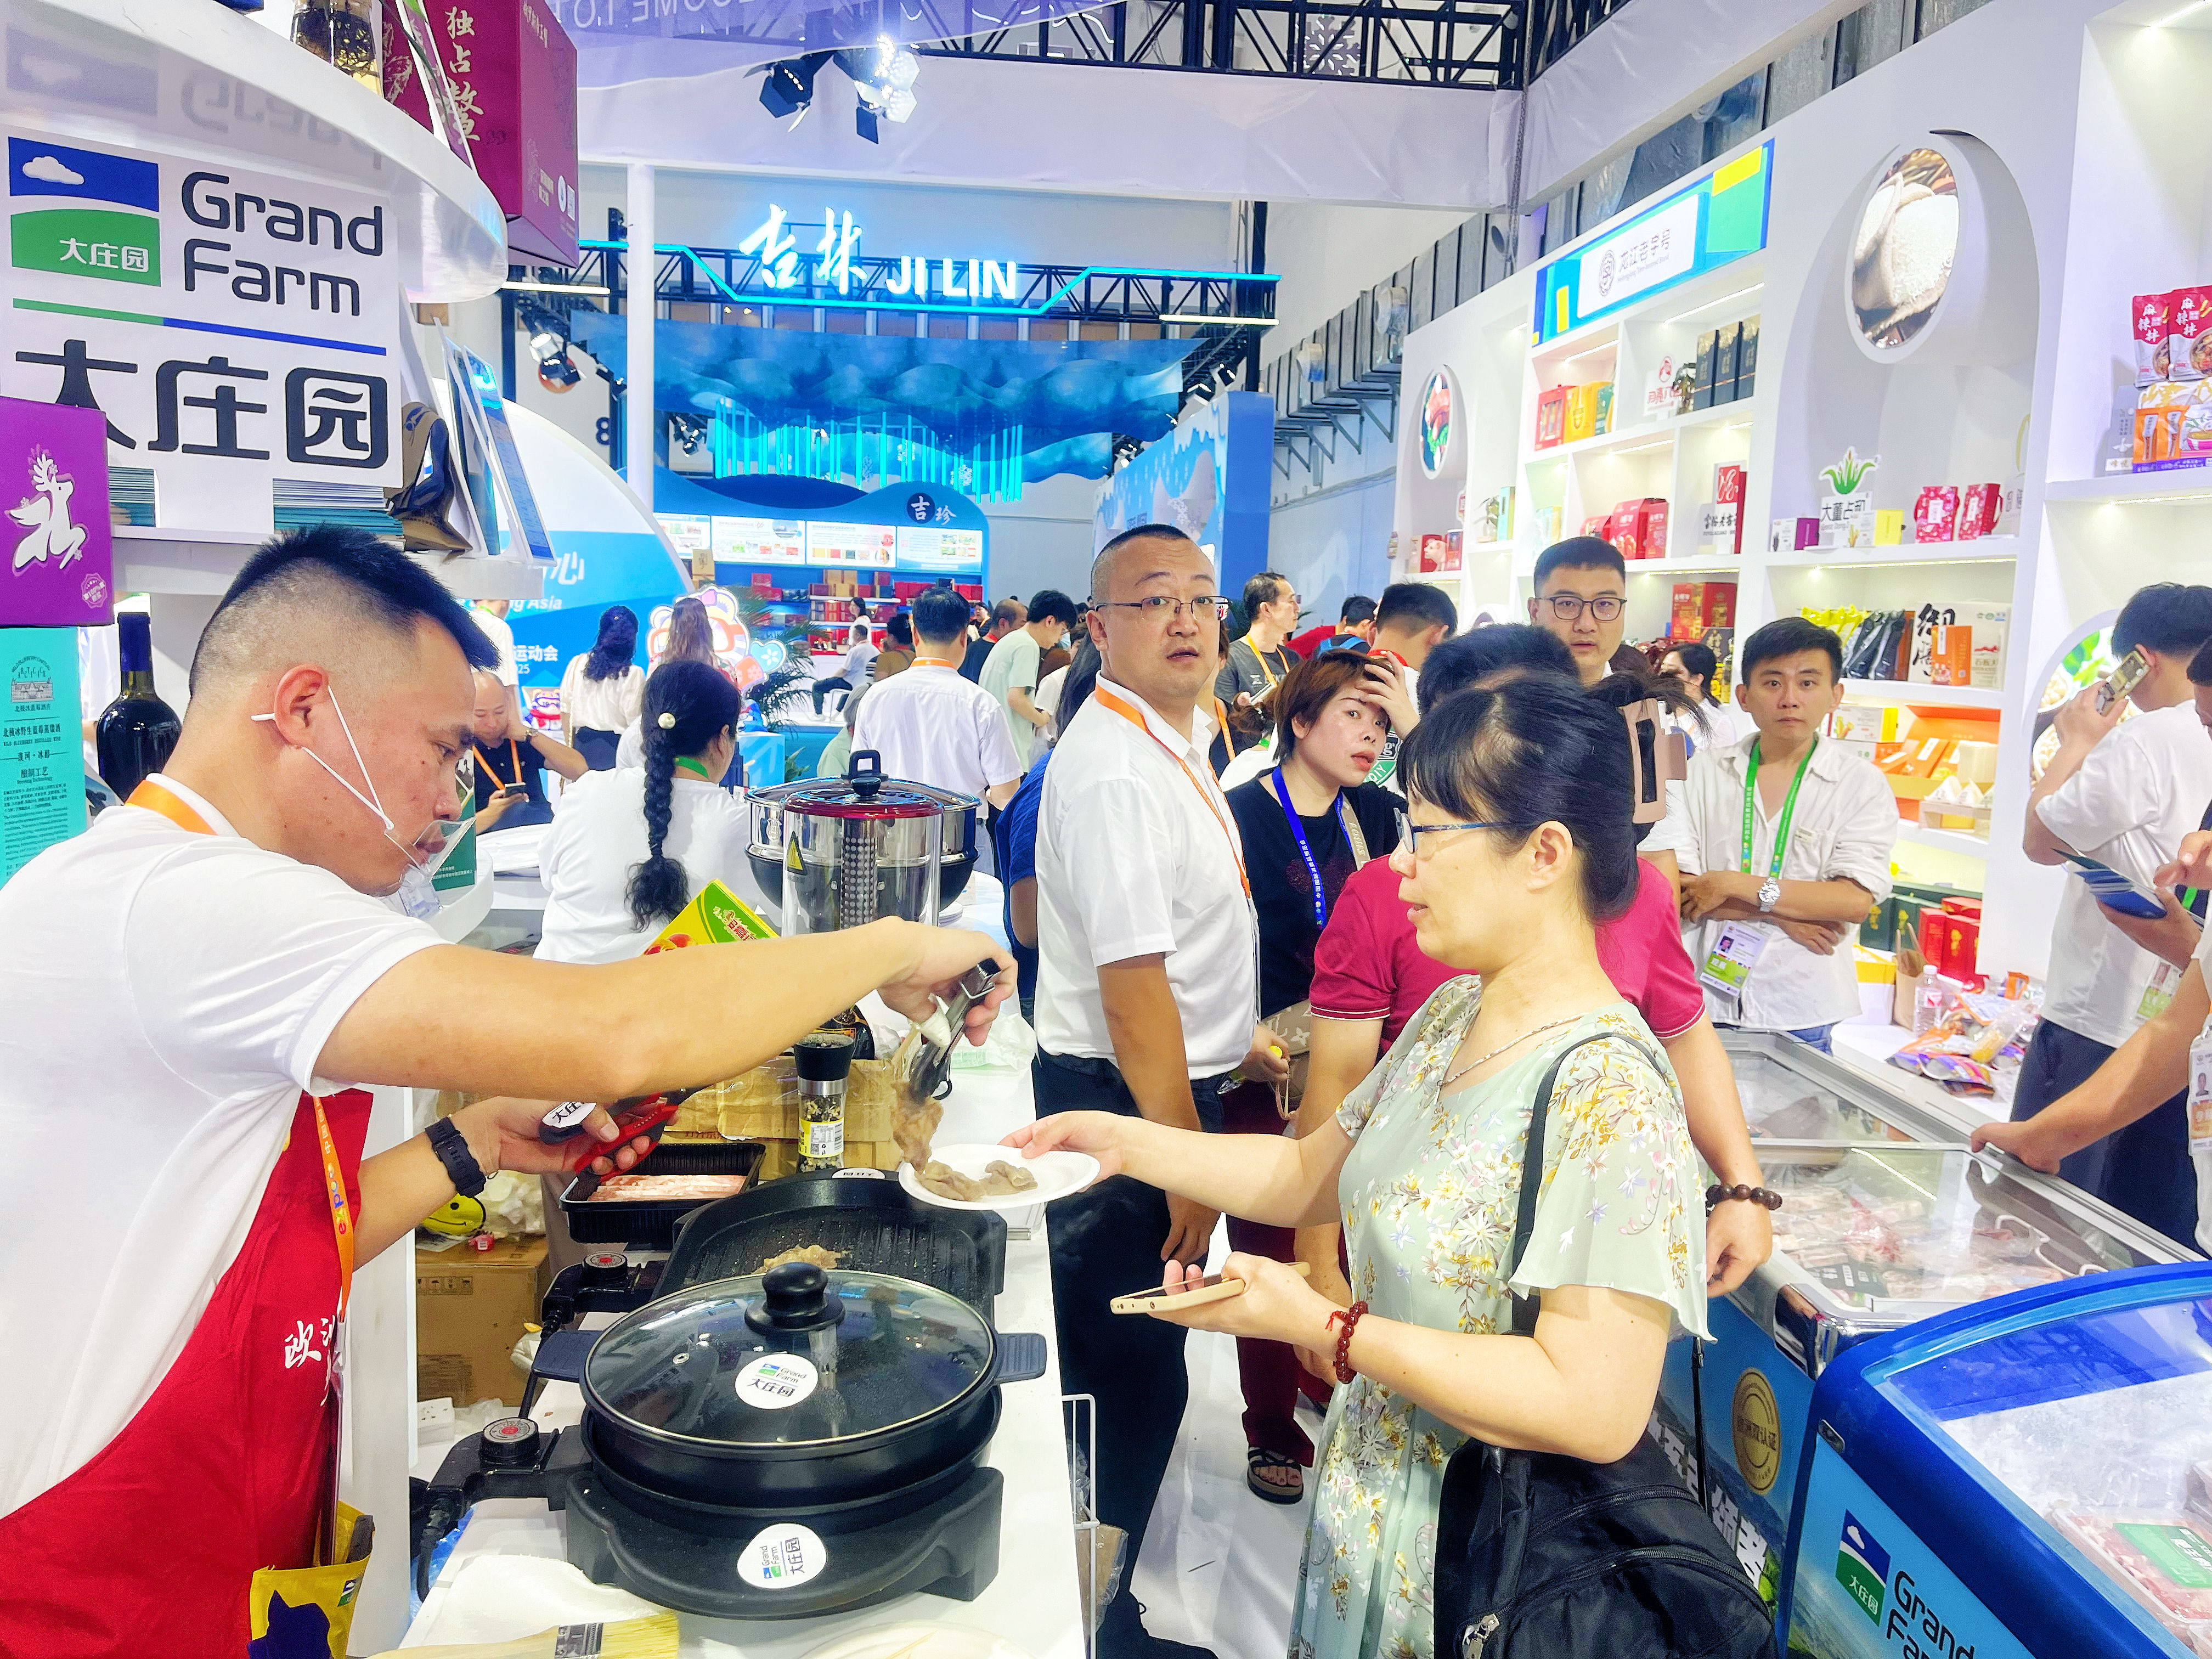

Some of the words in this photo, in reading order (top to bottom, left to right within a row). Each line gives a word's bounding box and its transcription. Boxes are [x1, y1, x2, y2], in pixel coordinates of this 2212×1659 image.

[181, 172, 383, 256] Grand
[60, 238, 149, 273] 大庄园
[738, 204, 867, 295] 吉林
[887, 255, 926, 295] JI
[942, 257, 1017, 299] LIN
[185, 238, 360, 317] Farm
[15, 339, 388, 469] 大庄园
[910, 496, 956, 526] 吉珍
[528, 596, 562, 610] Asia
[747, 1379, 795, 1397] 大庄园
[776, 1373, 799, 1384] Farm
[781, 1367, 807, 1379] Grand
[760, 1545, 770, 1566] Grand
[771, 1546, 780, 1565] Farm
[785, 1537, 805, 1575] 大庄园
[1849, 1575, 1878, 1615] 大庄园
[1886, 1609, 1930, 1659] Fa
